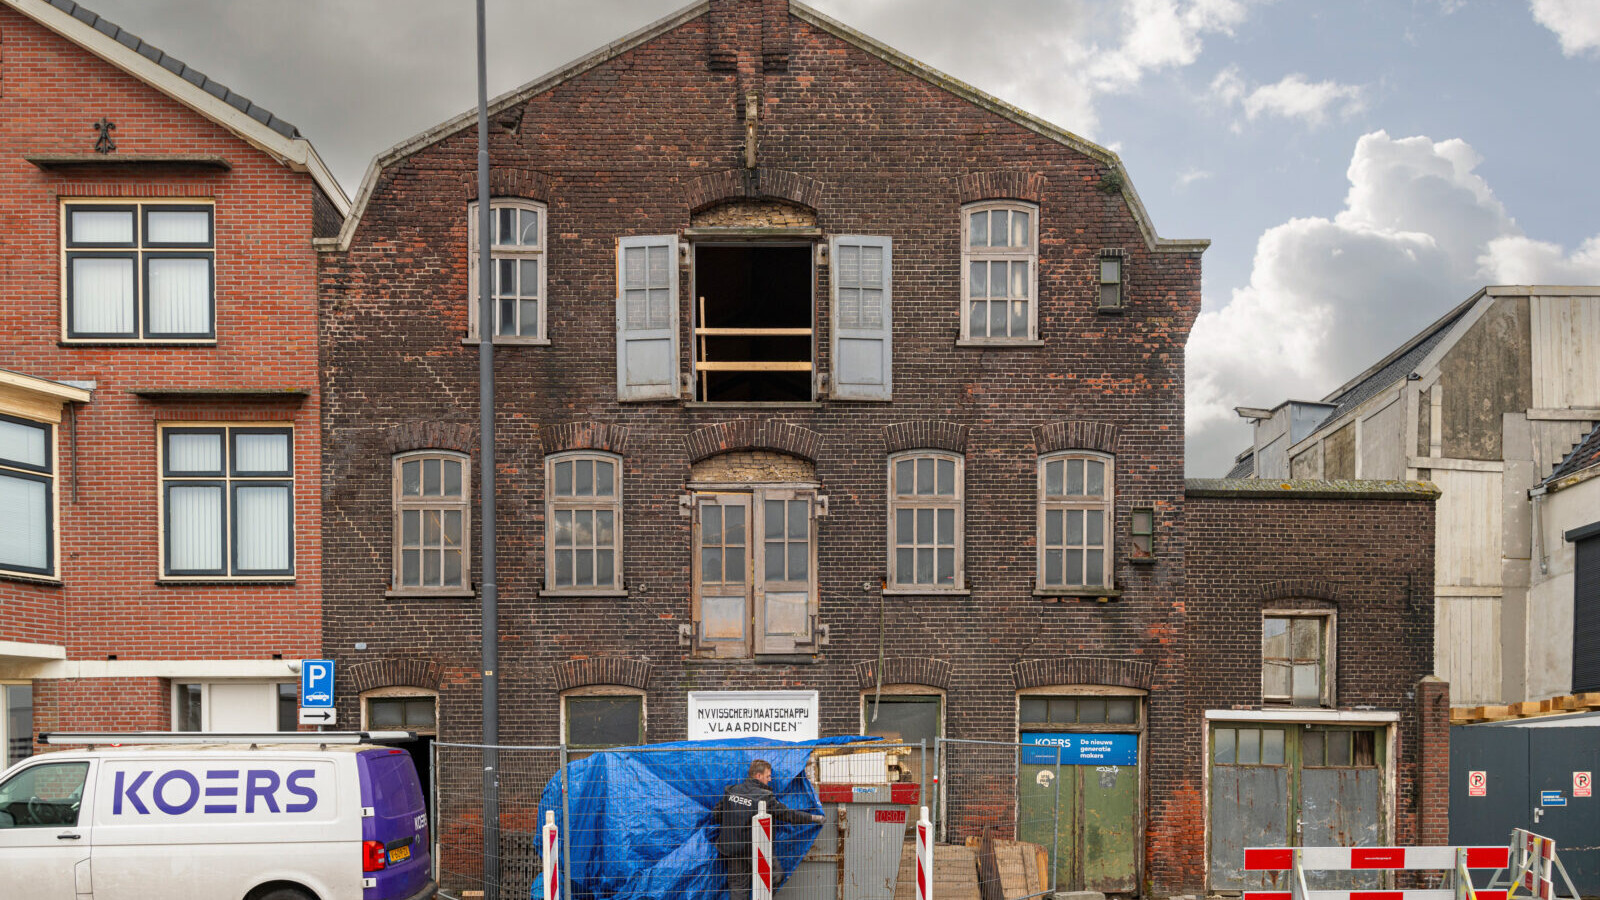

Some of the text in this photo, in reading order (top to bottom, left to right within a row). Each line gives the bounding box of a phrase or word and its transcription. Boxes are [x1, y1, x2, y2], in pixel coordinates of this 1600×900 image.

[309, 664, 327, 689] P
[753, 708, 809, 719] MAATSCHAPPIJ
[1080, 746, 1111, 754] generatie
[112, 769, 318, 816] KOERS
[728, 794, 753, 807] KOERS
